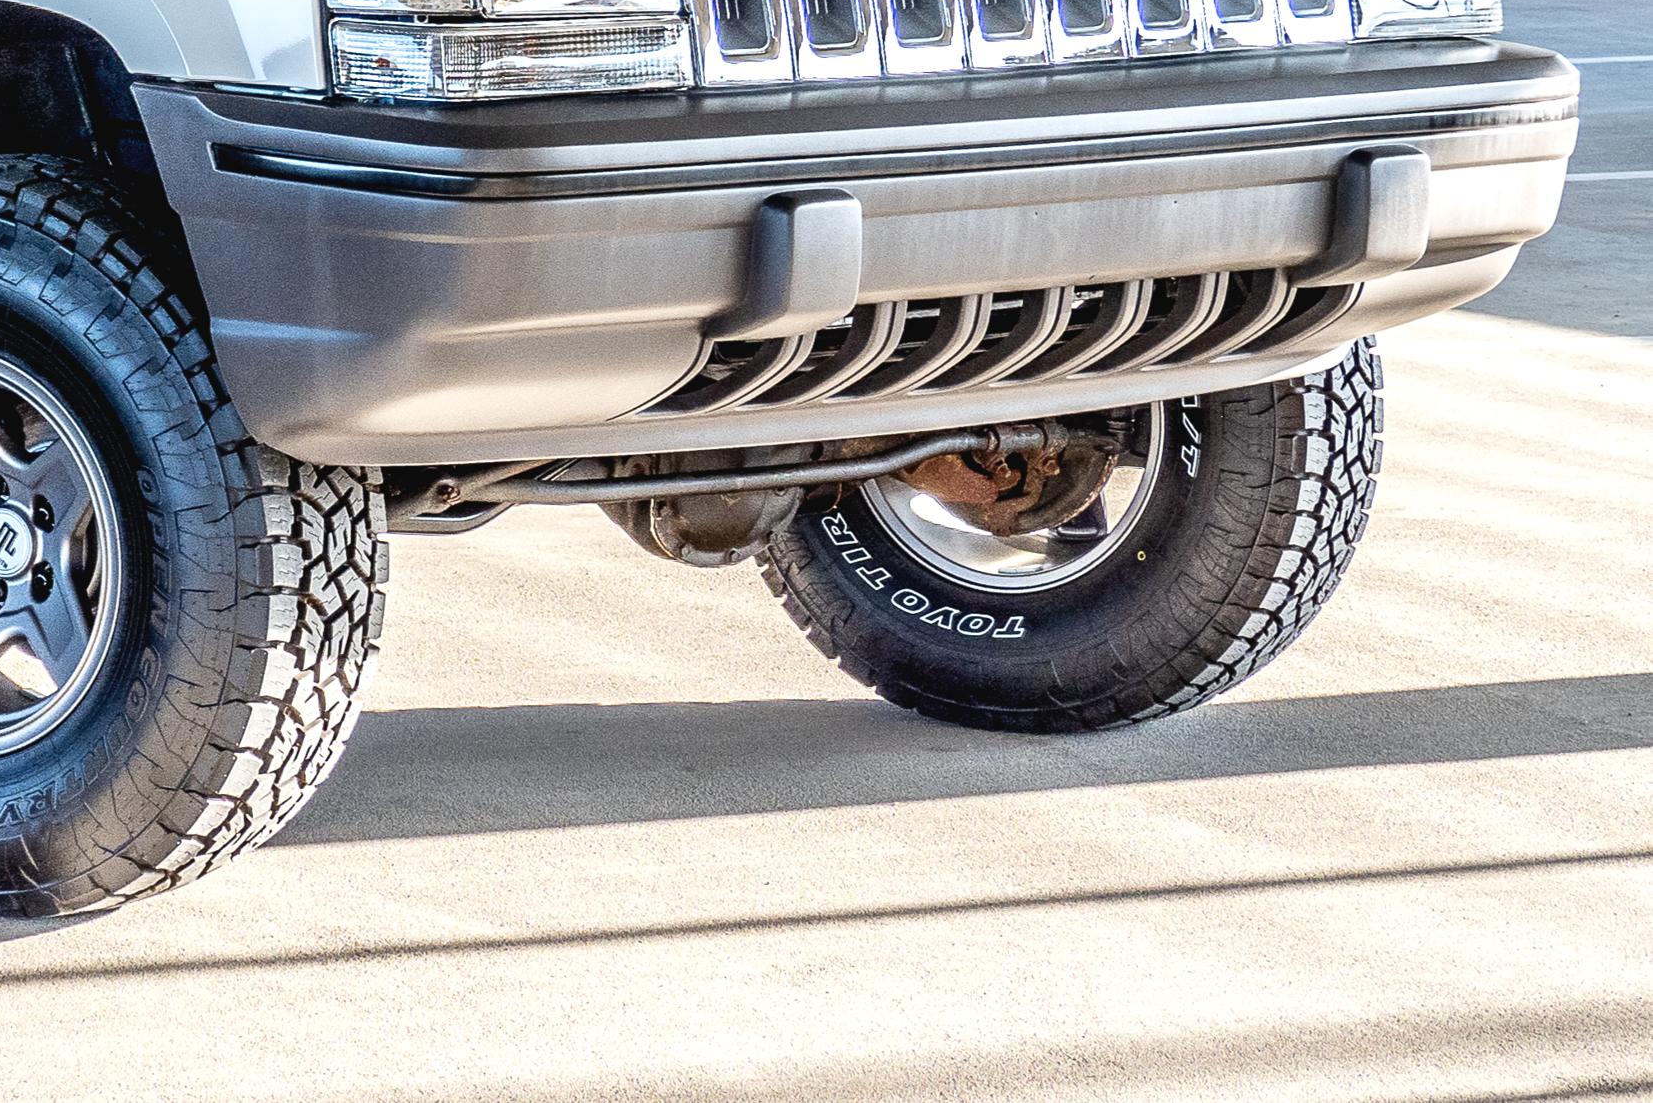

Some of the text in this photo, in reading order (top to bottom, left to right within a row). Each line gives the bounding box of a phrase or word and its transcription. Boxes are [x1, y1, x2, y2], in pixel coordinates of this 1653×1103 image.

[1181, 394, 1201, 478] /T
[136, 465, 172, 639] OPEN
[891, 588, 1025, 638] TOYO
